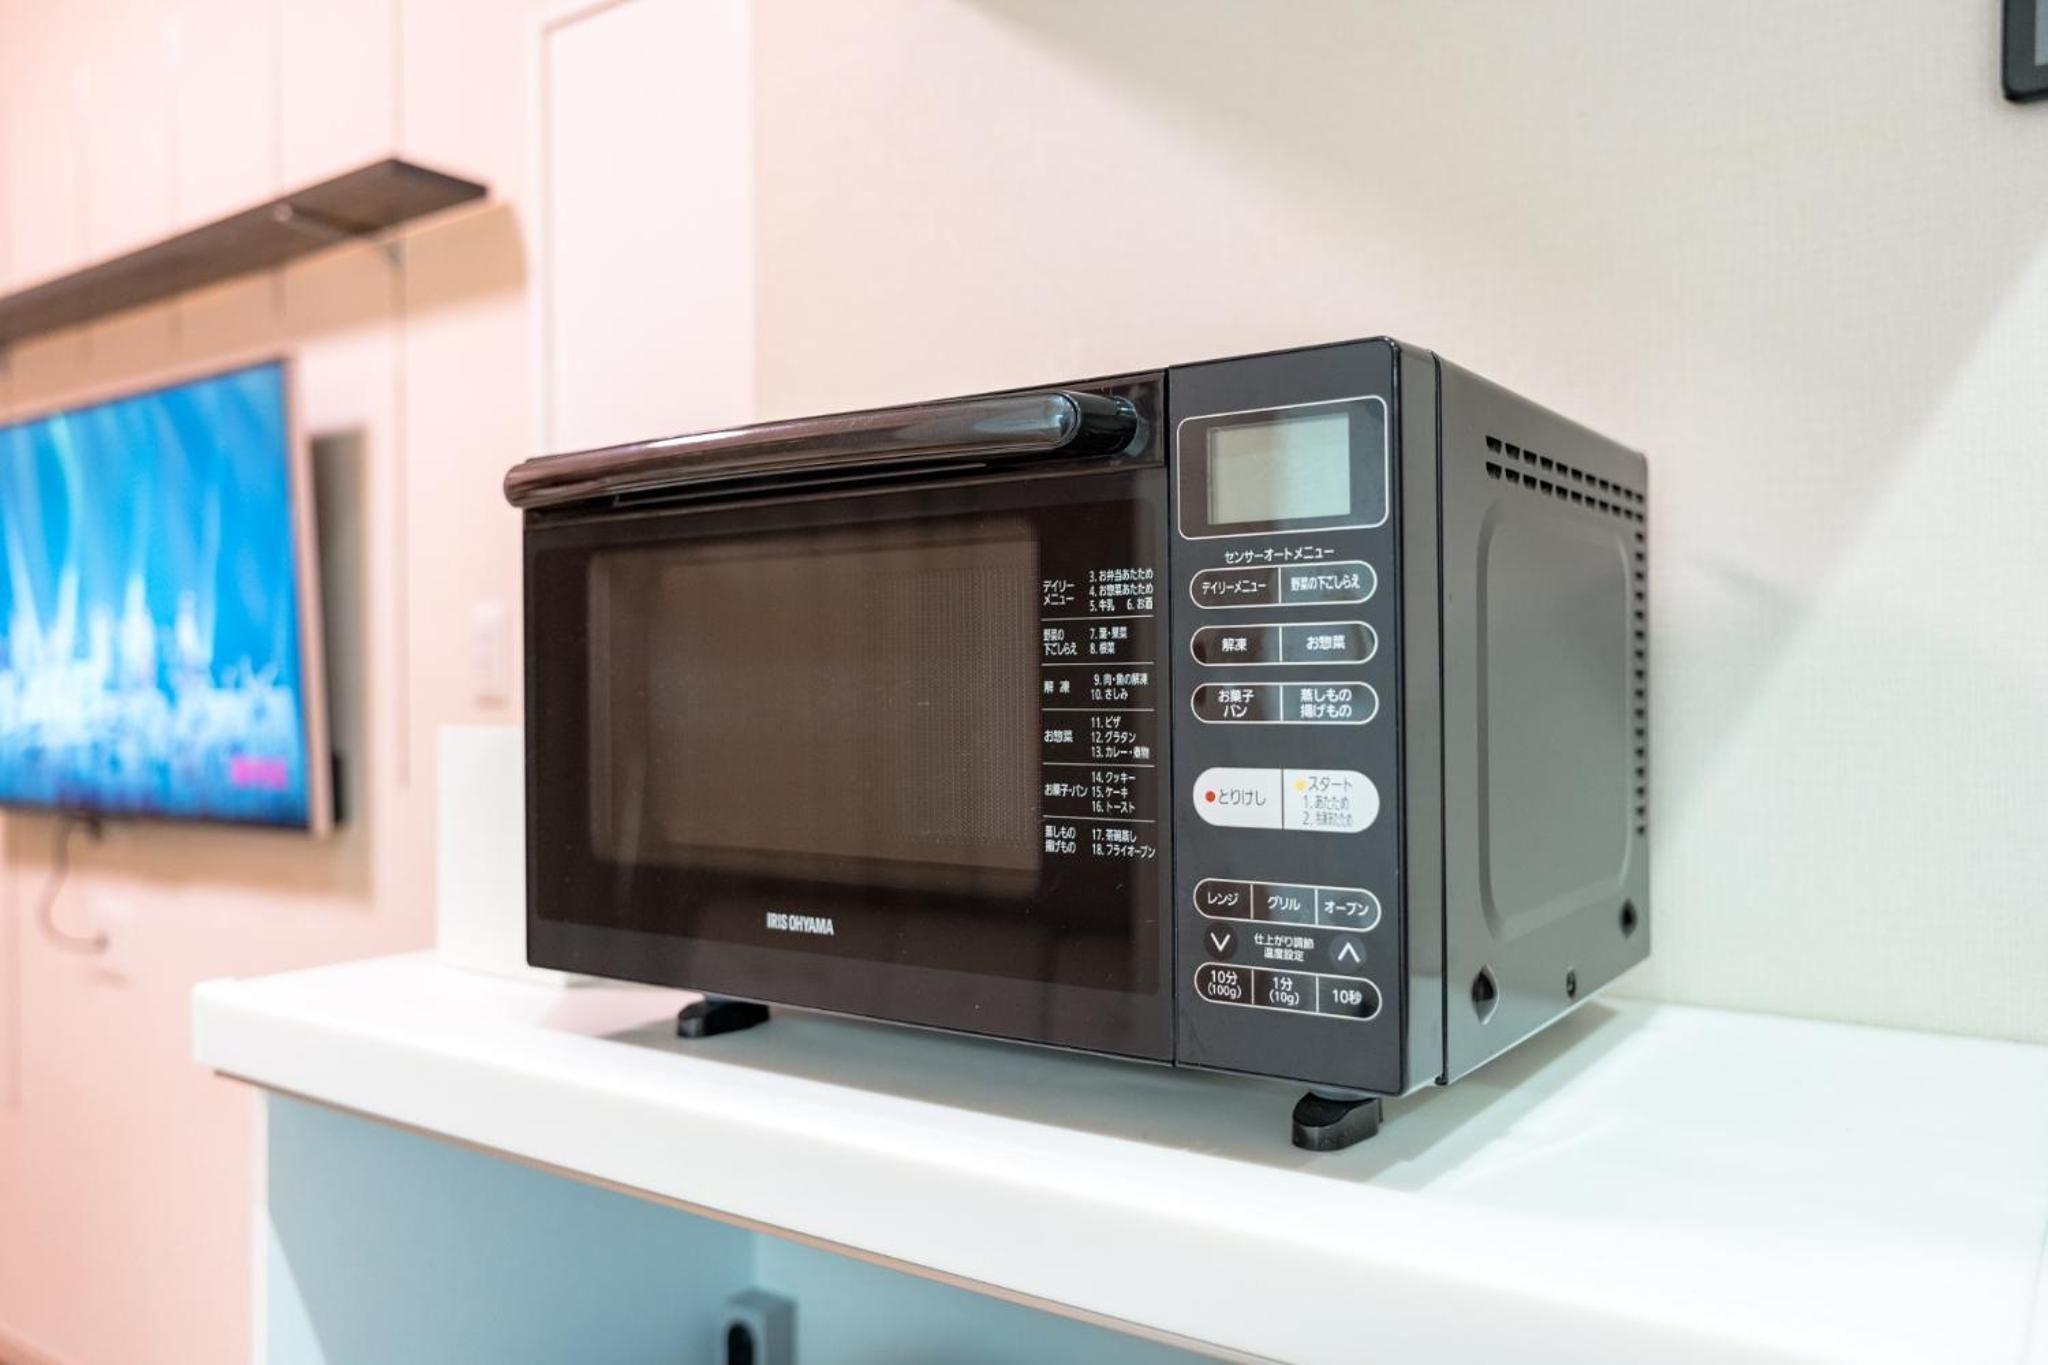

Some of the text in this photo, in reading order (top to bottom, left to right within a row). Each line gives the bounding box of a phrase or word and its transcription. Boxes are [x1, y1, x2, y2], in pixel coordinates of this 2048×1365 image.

[1224, 546, 1335, 564] センサーオートメニュー
[1043, 580, 1075, 593] デイリー
[1202, 579, 1266, 595] デイリーメニュー
[1290, 574, 1360, 591] 野菜の下ごしらえ
[1043, 593, 1075, 606] メニュー
[1043, 642, 1077, 656] 下ごしらえ
[1221, 637, 1247, 652] 解凍
[1305, 635, 1345, 650] お惣菜
[1218, 689, 1254, 703] お菓子
[1300, 688, 1352, 702] 蒸しもの
[1223, 704, 1248, 718] パン
[1300, 704, 1351, 719] 揚げもの
[1044, 730, 1073, 743] お惣菜
[1308, 775, 1352, 791] スタート
[1218, 788, 1267, 806] とりけし
[1045, 825, 1076, 839] 蒸しもの
[1045, 839, 1076, 854] 揚げもの
[1207, 892, 1239, 906] レンジ
[1267, 896, 1301, 911] グリル
[1324, 901, 1369, 916] オーブン
[766, 912, 834, 936] IRIS OHYAMA
[1254, 933, 1314, 949] 仕上がり調節
[1264, 948, 1304, 962] 温度設定
[1210, 970, 1238, 985] 10分
[1273, 976, 1293, 991] 1分
[1207, 984, 1242, 1000] (100g)
[1269, 989, 1300, 1006] (10g)
[1332, 989, 1363, 1005] 10秒
